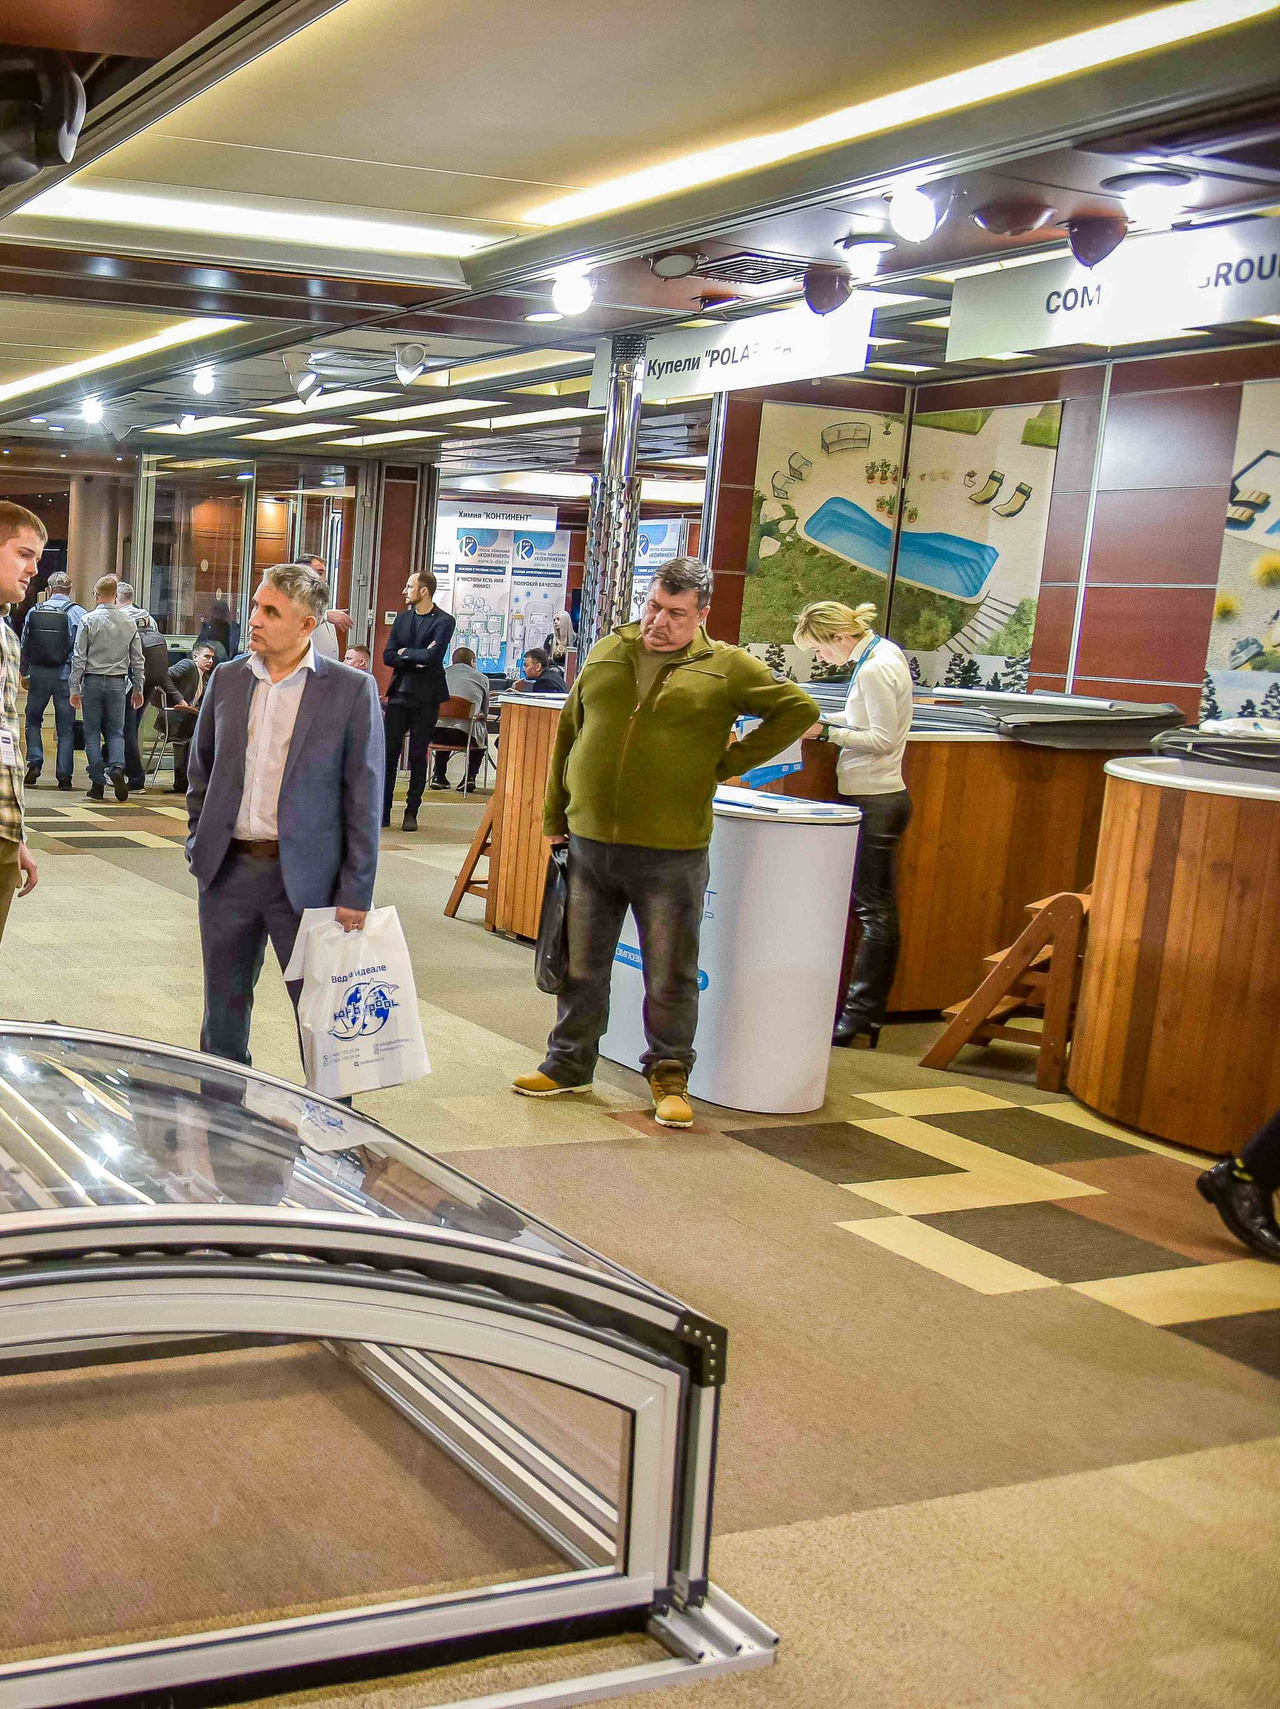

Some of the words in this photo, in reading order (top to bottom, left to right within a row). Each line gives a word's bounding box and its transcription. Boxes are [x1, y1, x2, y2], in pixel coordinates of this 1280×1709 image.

[1198, 253, 1280, 289] ROU
[704, 343, 750, 368] "POLA
[646, 356, 702, 381] Купели
[458, 511, 482, 519] Химия
[484, 511, 532, 521] "КОНТИНЕНТ"
